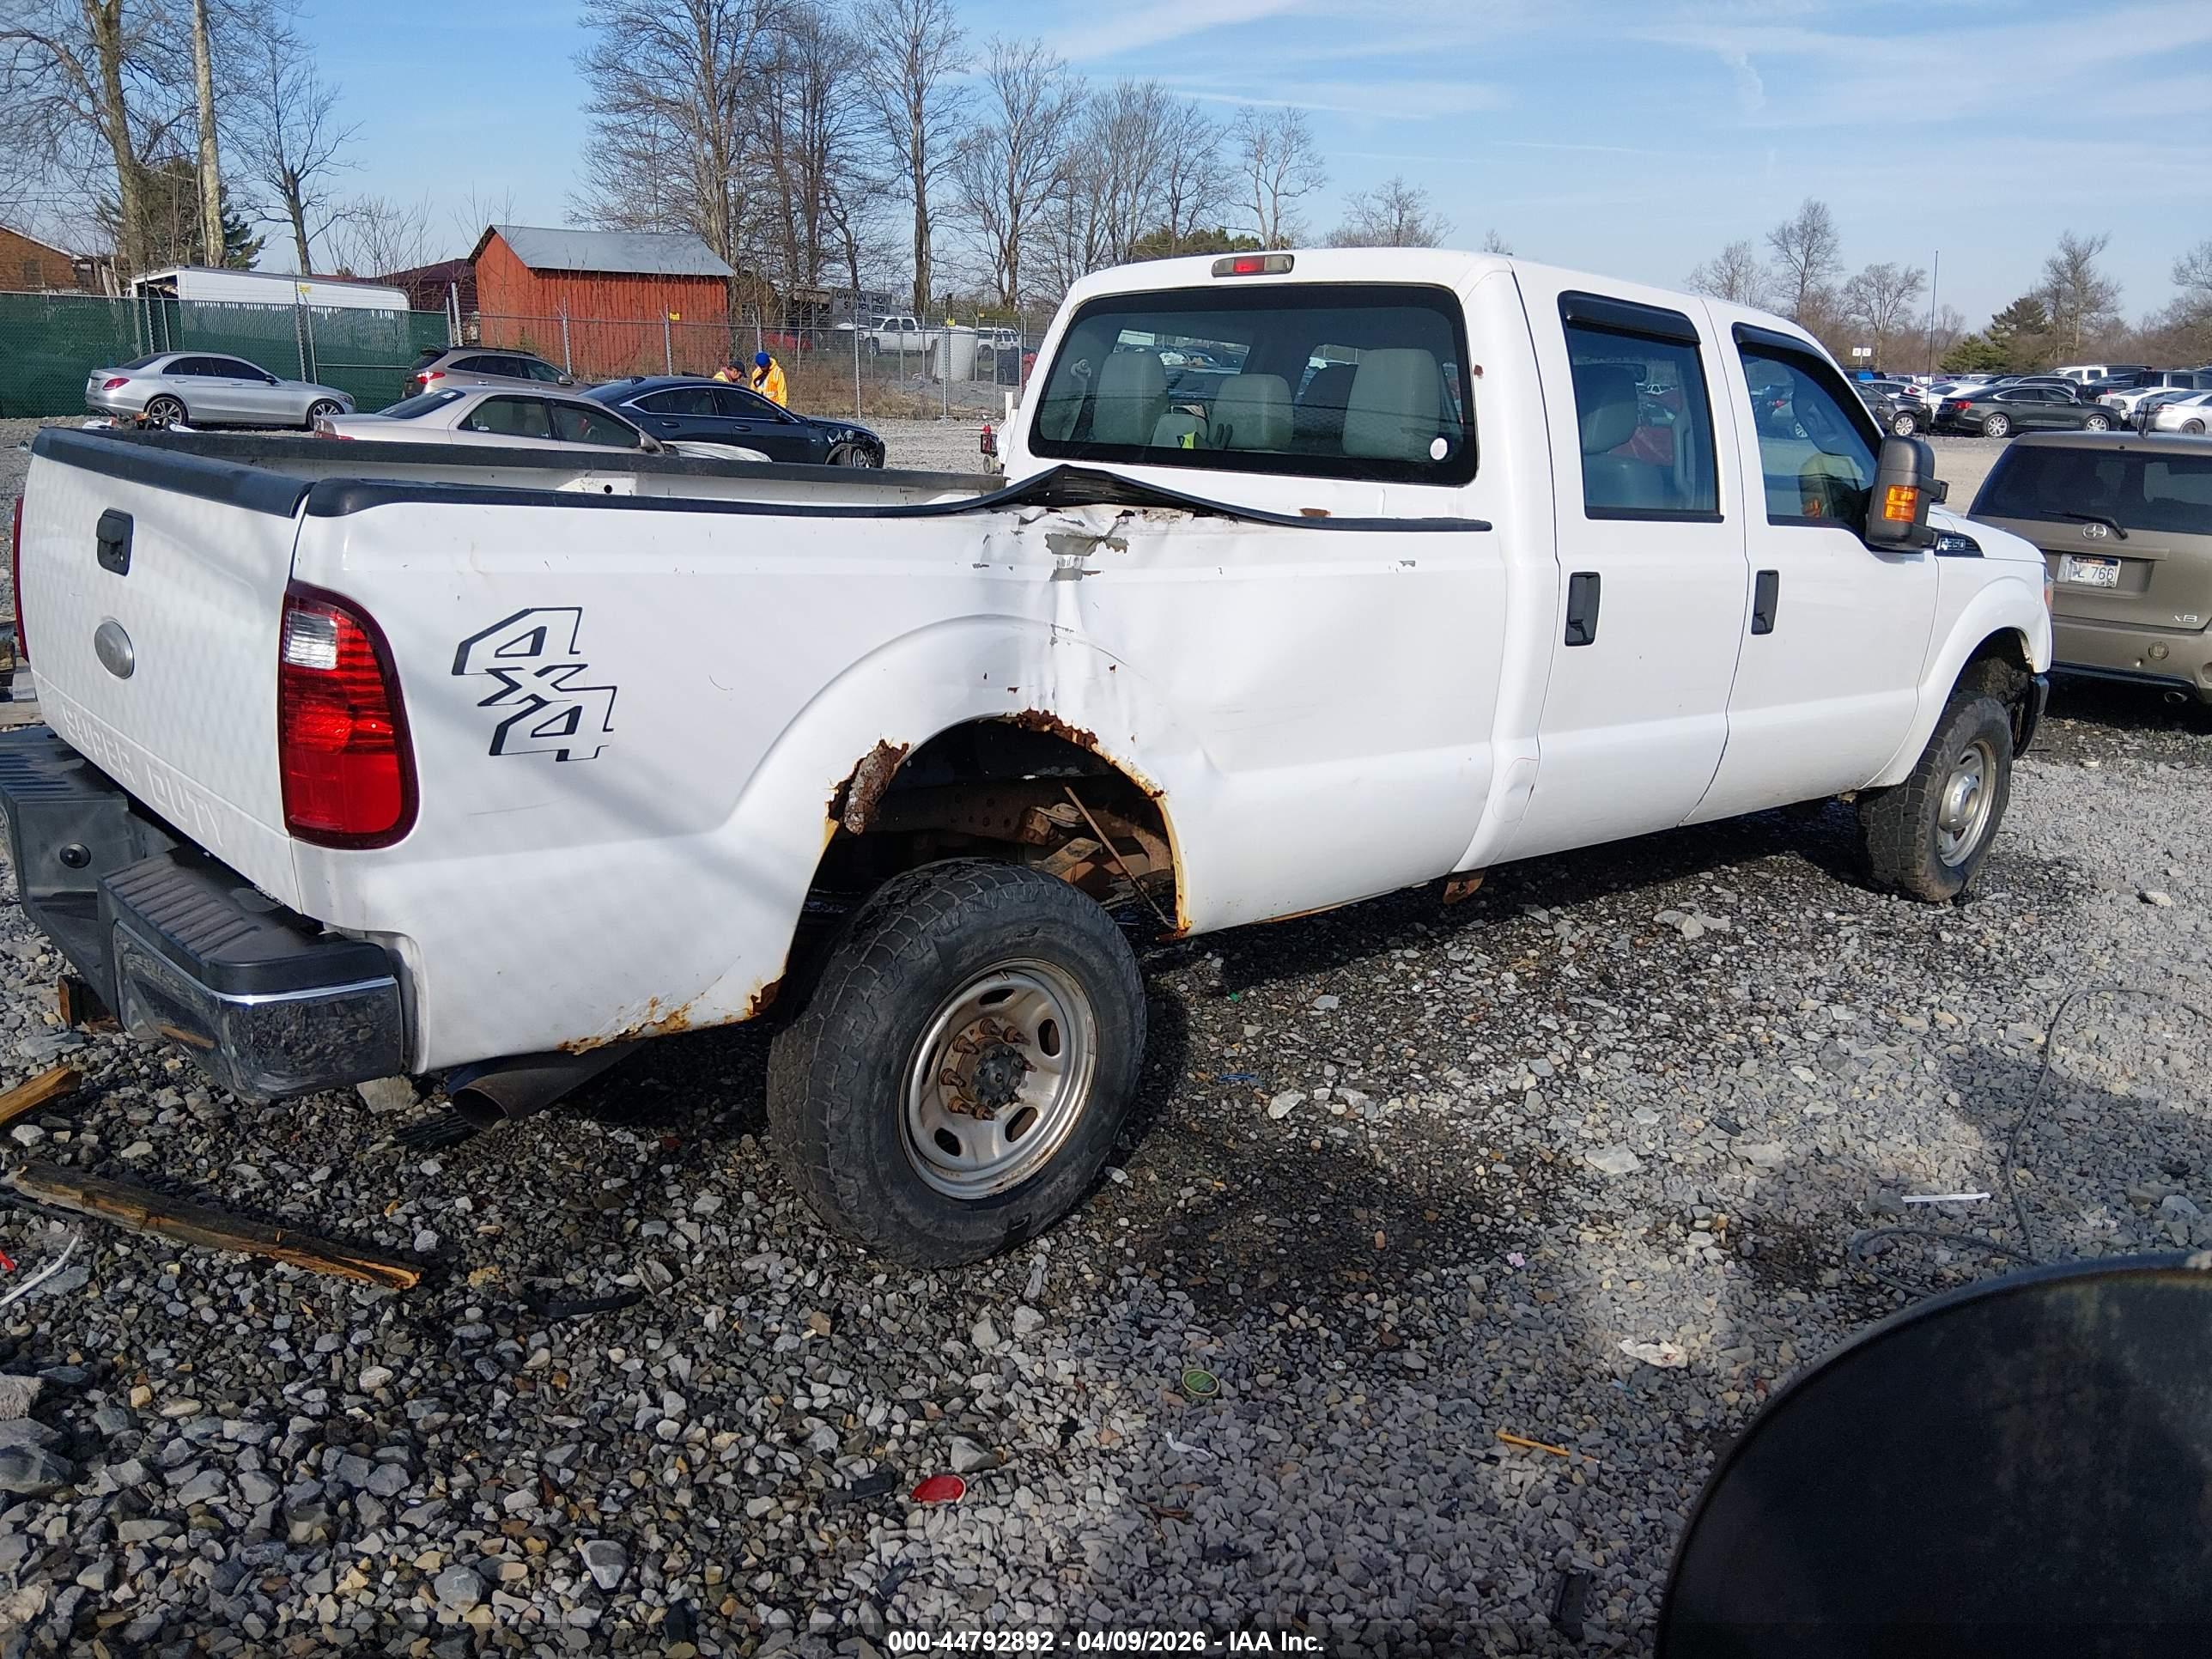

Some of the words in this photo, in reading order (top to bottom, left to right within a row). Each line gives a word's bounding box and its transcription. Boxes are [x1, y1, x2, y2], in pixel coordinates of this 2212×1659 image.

[2091, 566, 2115, 581] 766
[61, 702, 137, 785] SUPER
[145, 761, 225, 848] DUTY
